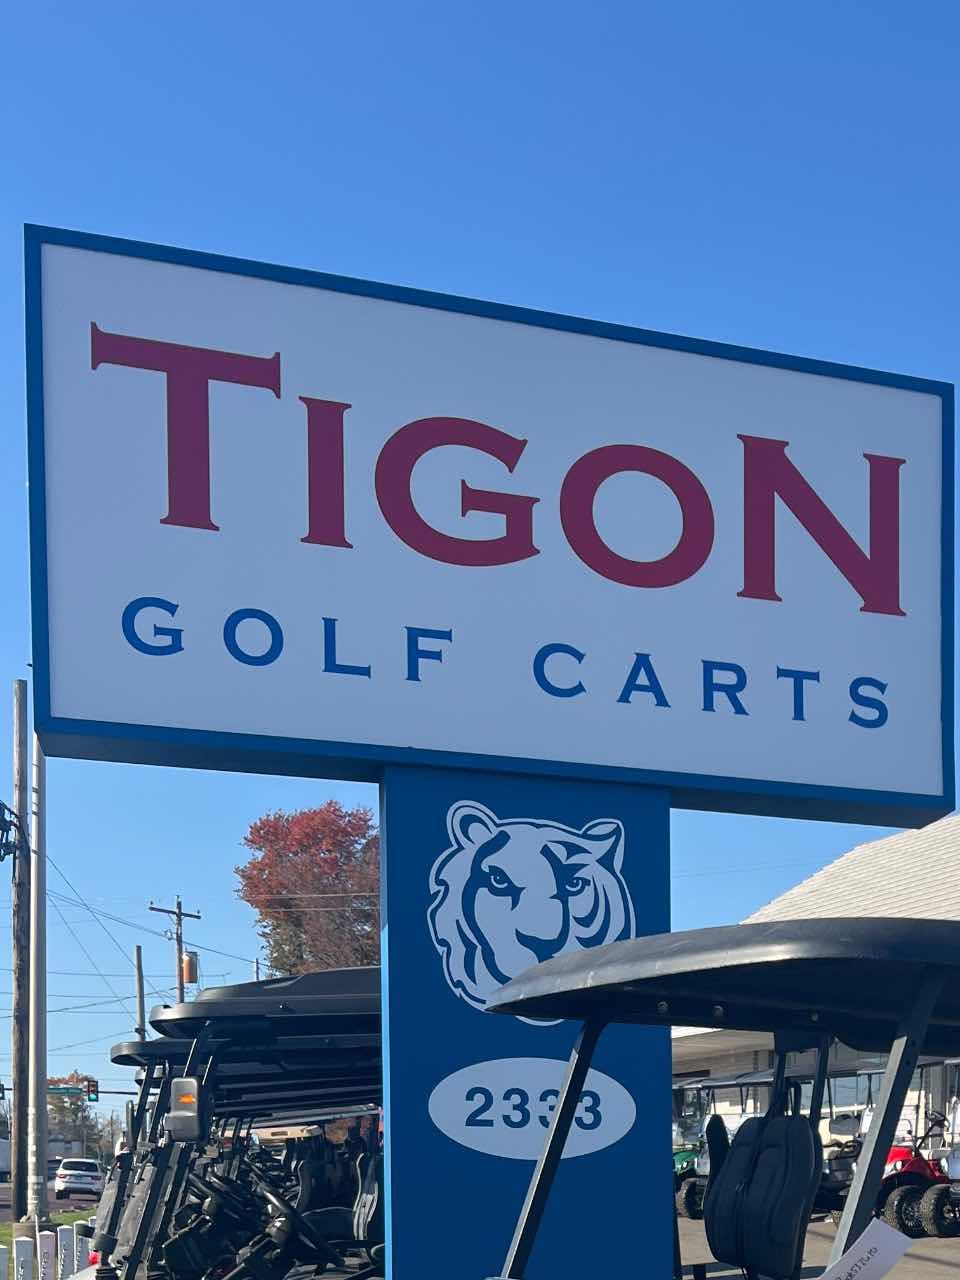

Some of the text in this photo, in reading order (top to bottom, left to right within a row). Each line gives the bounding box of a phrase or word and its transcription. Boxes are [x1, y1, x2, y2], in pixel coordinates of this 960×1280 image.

[90, 322, 908, 617] TIGON
[121, 596, 891, 730] GOLF CARTS
